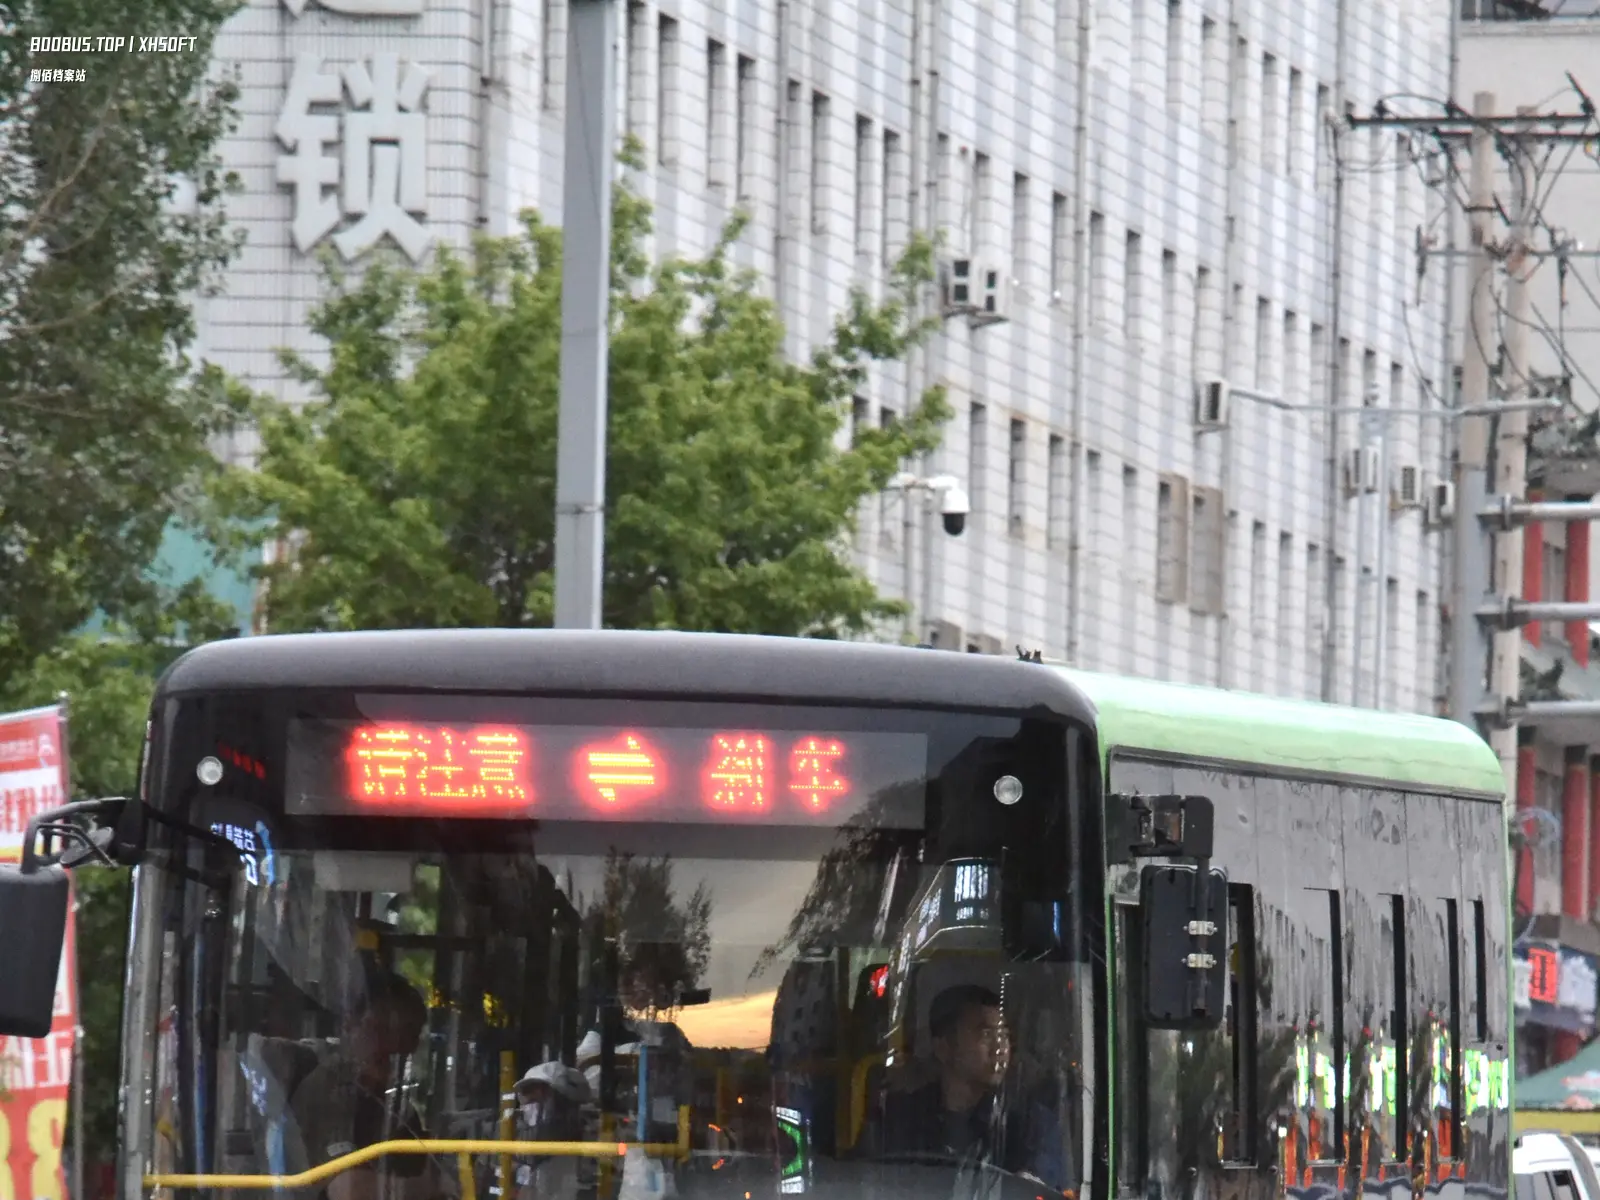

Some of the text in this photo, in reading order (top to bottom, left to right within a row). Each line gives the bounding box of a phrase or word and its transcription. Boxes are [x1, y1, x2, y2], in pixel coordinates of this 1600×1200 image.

[275, 0, 437, 263] 锁
[356, 728, 526, 800] 请注意
